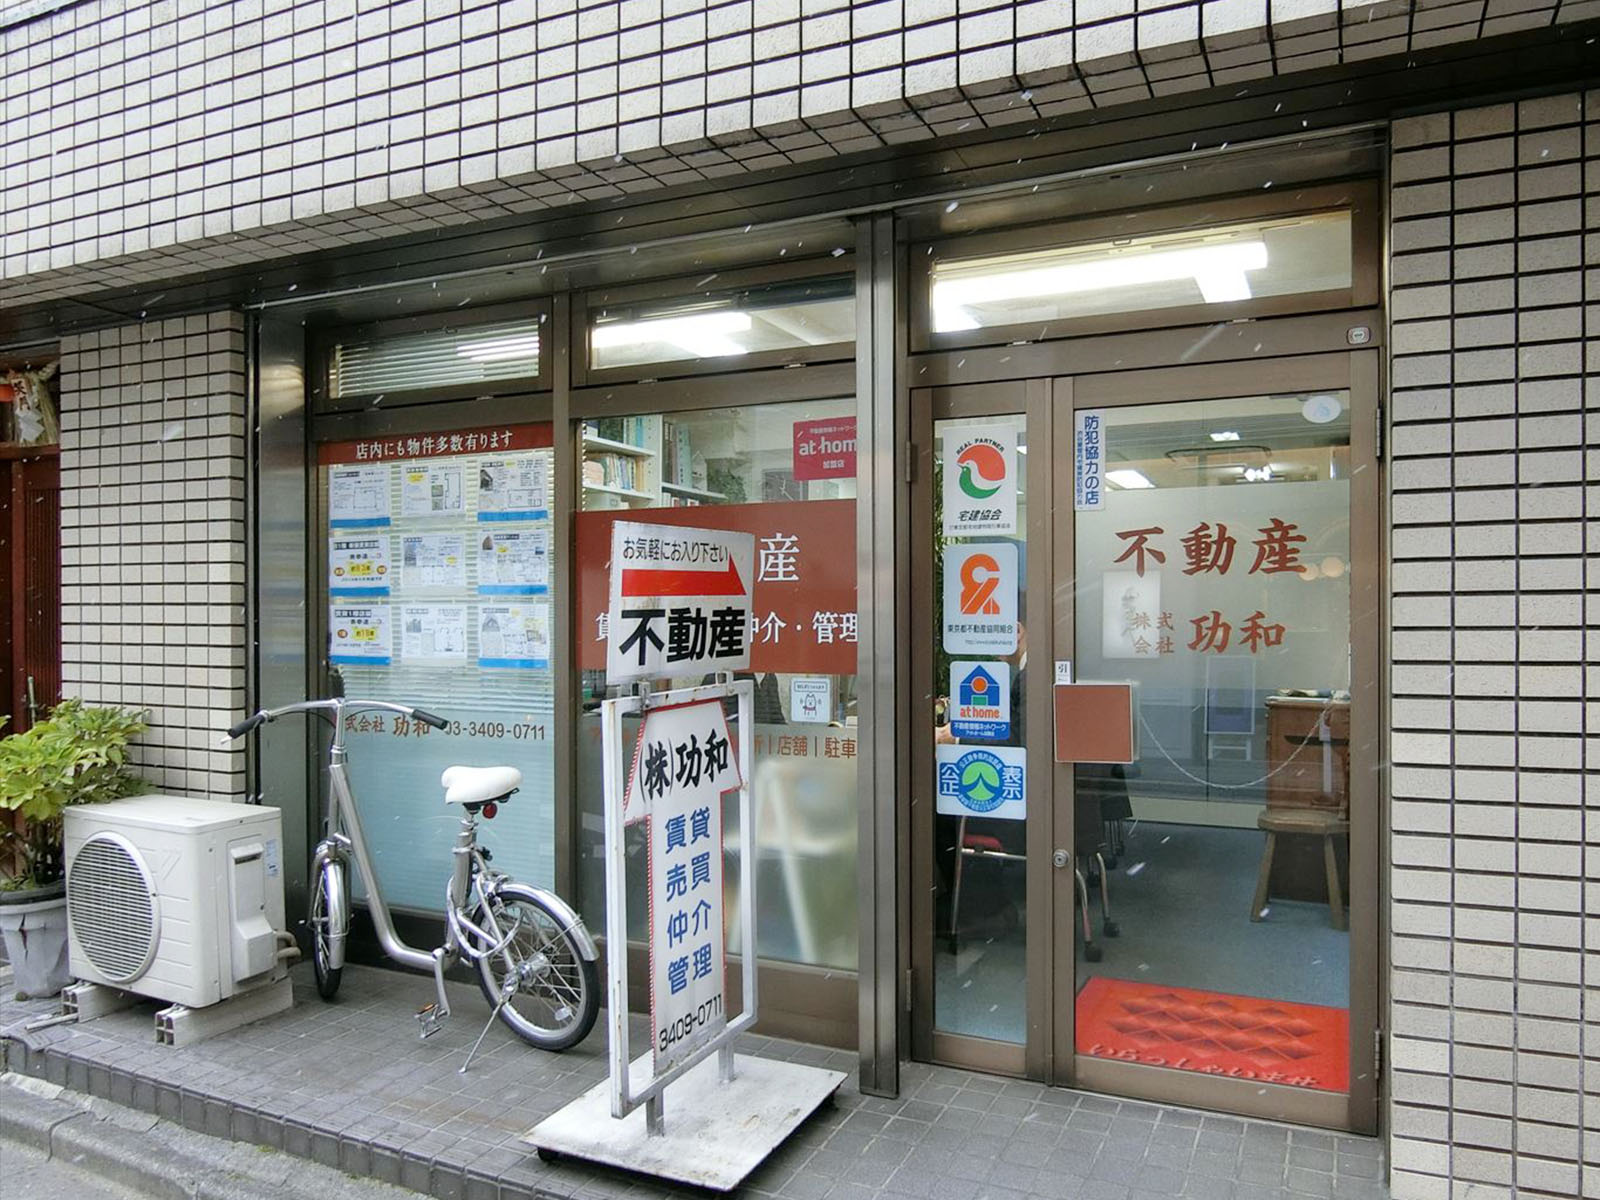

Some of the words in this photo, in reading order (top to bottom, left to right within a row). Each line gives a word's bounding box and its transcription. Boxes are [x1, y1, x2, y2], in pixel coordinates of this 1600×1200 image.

[356, 430, 513, 459] 店内にも物件多数有ります
[799, 440, 816, 456] at
[820, 436, 857, 454] hom
[956, 441, 972, 455] REAL
[974, 438, 1004, 453] PARTNER
[1084, 416, 1100, 505] 防犯協力の店
[958, 509, 1002, 521] 宅建協会
[623, 537, 728, 563] お気軽にお入り下さい
[1114, 518, 1307, 577] 不動産
[619, 606, 746, 667] 不動産
[1188, 611, 1285, 653] 功和
[345, 715, 386, 733] 式会社
[393, 713, 431, 737] 功和
[960, 706, 971, 718] at
[972, 707, 999, 719] home
[778, 736, 808, 757] 店舗
[639, 728, 729, 804] (株)功和
[941, 764, 960, 795] 公正
[1002, 767, 1022, 799] 表示
[665, 806, 711, 854] 賃貸
[666, 852, 711, 902] 売買
[667, 899, 712, 949] 仲介
[668, 943, 712, 995] 管理
[659, 993, 722, 1051] 3409-0711
